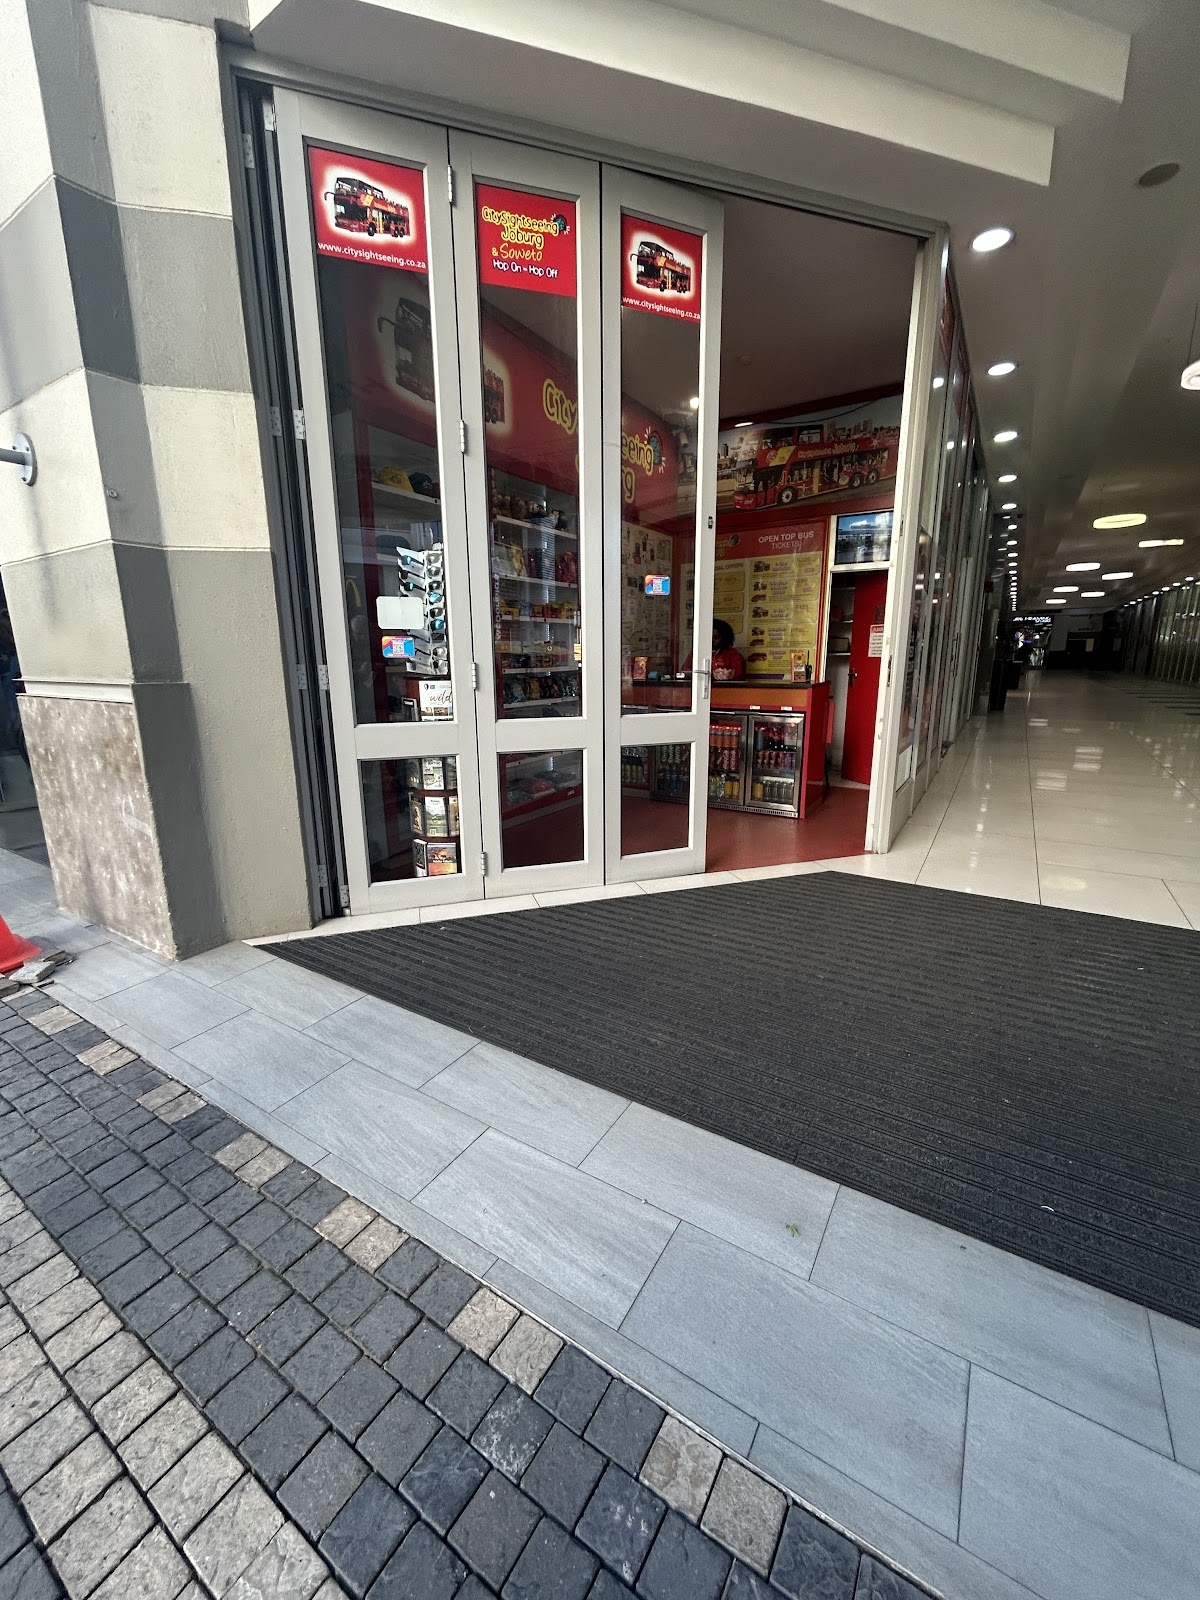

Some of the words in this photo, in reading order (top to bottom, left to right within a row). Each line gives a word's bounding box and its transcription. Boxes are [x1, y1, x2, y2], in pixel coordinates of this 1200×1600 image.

[501, 225, 544, 250] Joburg
[318, 242, 426, 269] www.citysightseeing.co.za
[491, 247, 499, 257] &
[500, 243, 543, 261] Soweto
[493, 259, 509, 271] Hop
[510, 262, 522, 273] On
[529, 265, 544, 277] Hop
[546, 267, 558, 278] Off
[622, 296, 700, 319] www.citysightseeing.co.za
[758, 534, 779, 543] OPEN
[780, 532, 796, 541] TOP
[798, 530, 814, 540] BUS
[772, 540, 800, 549] TICKETS
